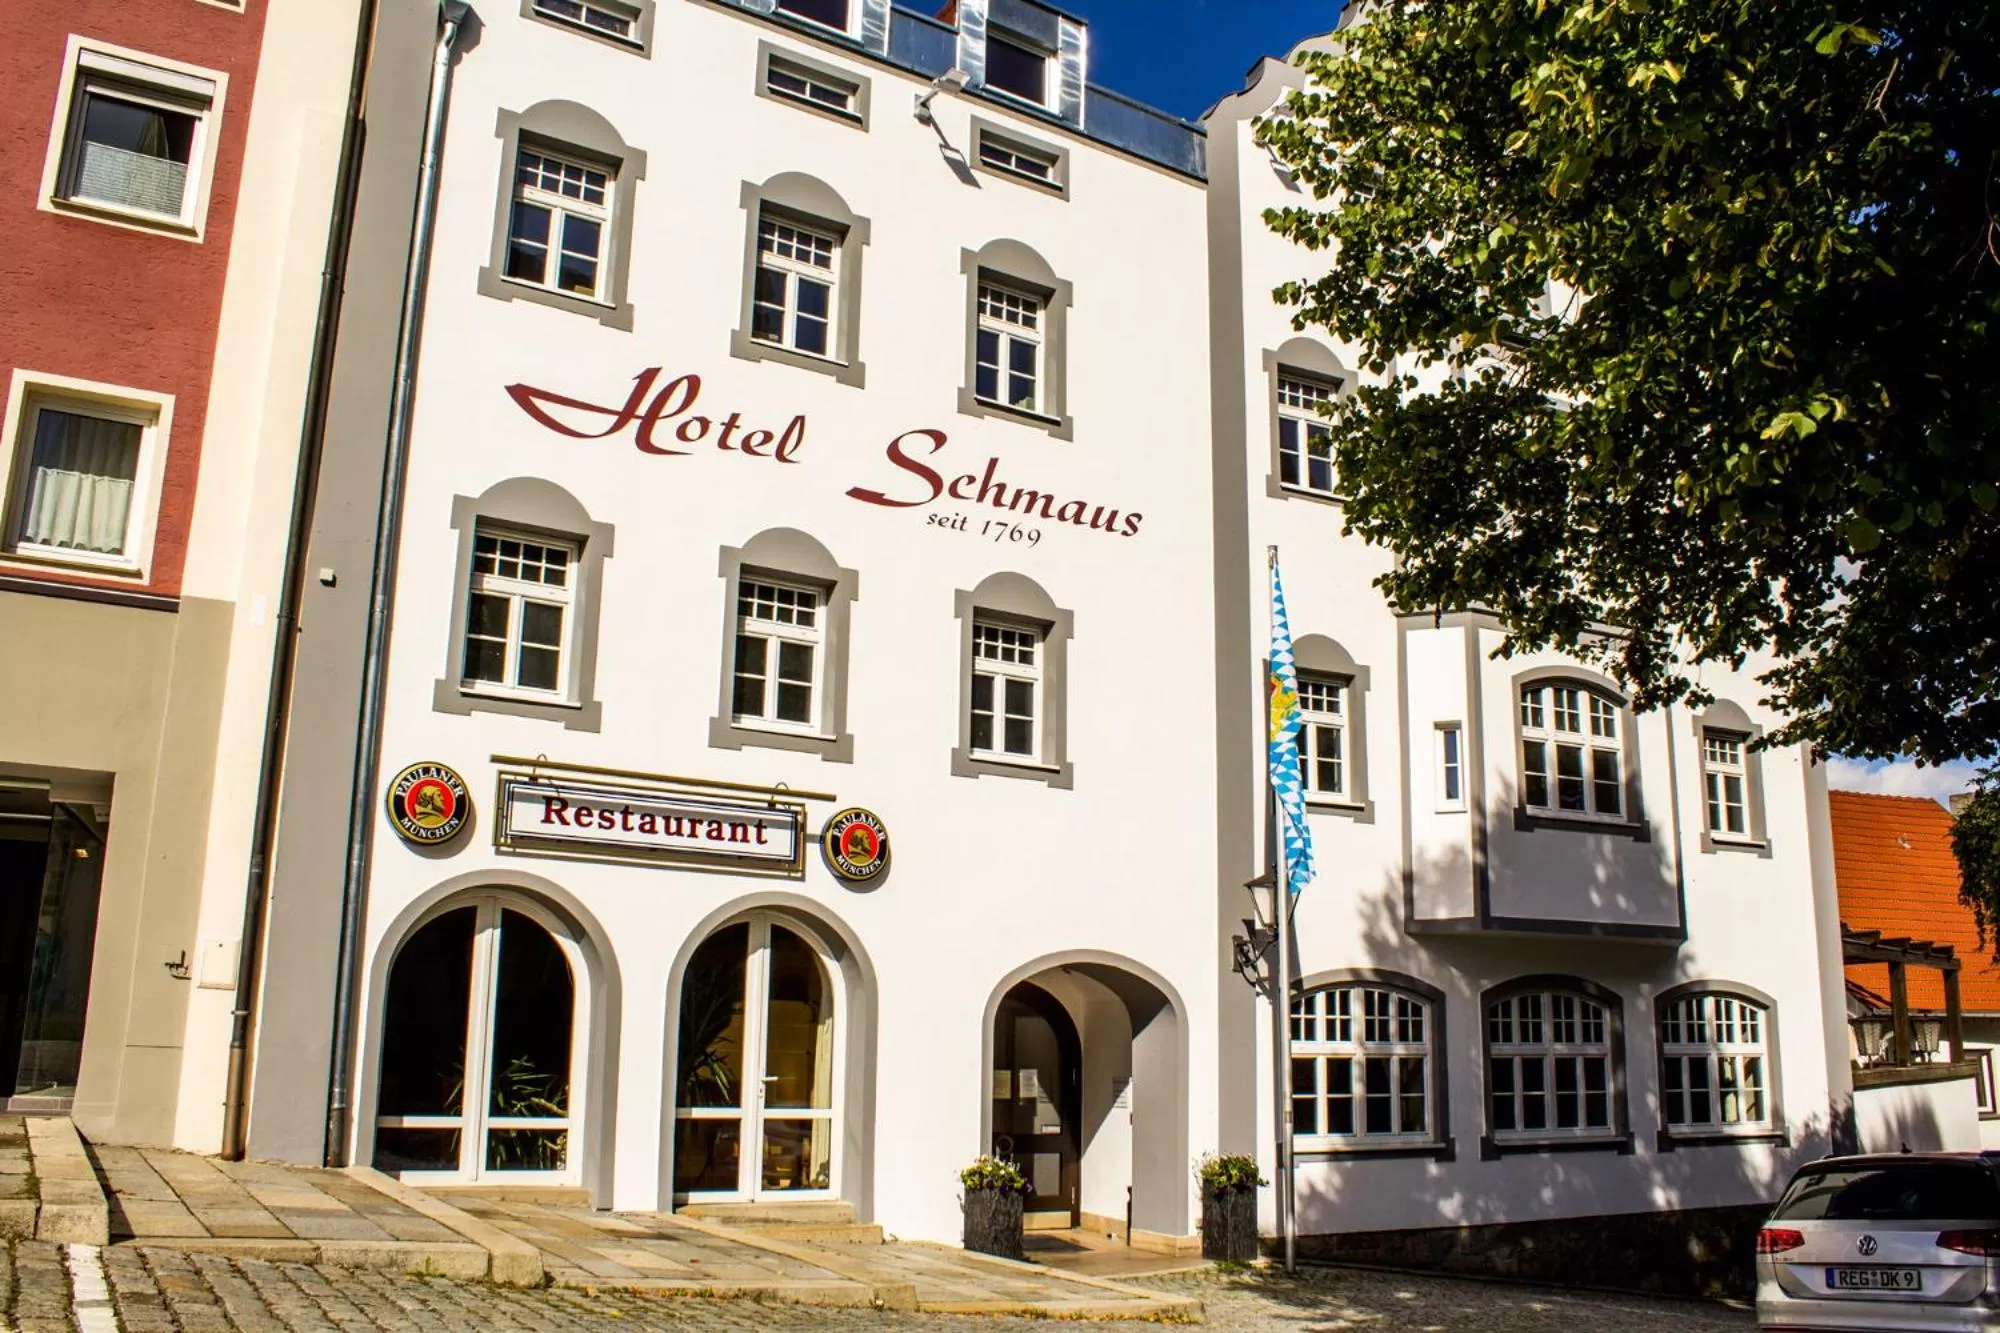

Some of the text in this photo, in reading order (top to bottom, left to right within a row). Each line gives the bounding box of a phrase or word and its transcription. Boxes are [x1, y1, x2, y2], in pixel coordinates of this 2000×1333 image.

[505, 367, 1142, 537] Hotel Schmaus
[926, 512, 1041, 549] seit 1769
[395, 767, 464, 797] PAULANER
[540, 795, 768, 845] Restaurant
[832, 813, 886, 843] PAULANER
[1839, 1270, 1914, 1287] REG DK 9
